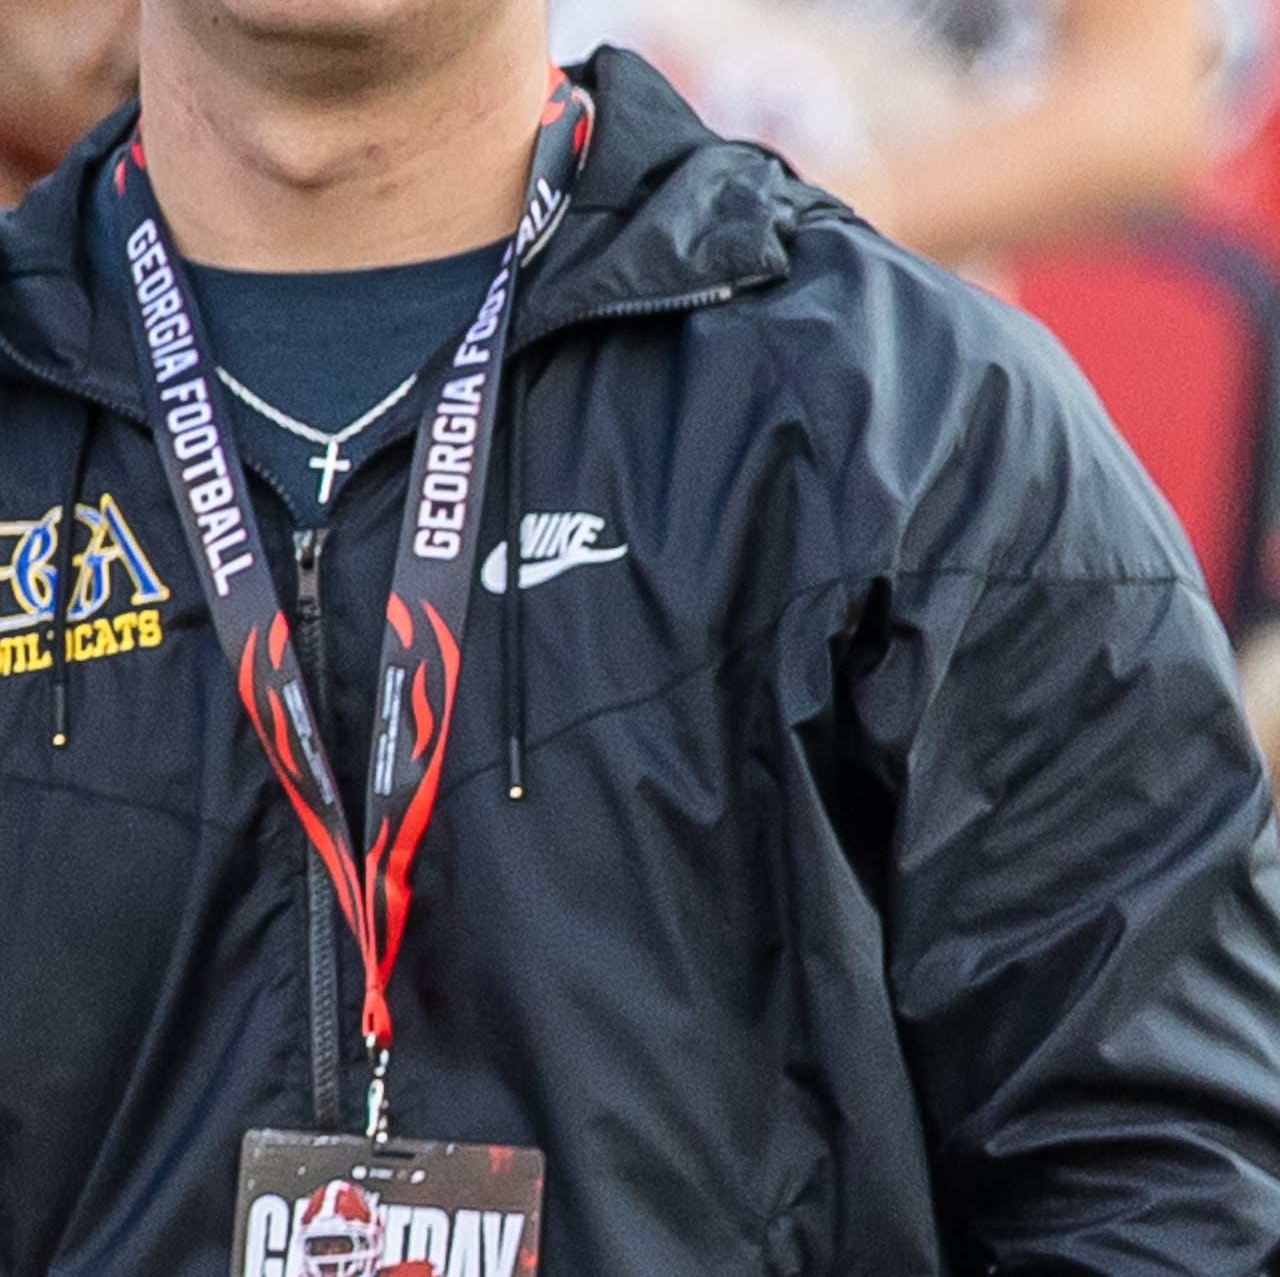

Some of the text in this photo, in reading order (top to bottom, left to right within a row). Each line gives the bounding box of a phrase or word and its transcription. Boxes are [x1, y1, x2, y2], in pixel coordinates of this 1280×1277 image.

[126, 219, 255, 597] GEORGIA FOOTBALL
[413, 372, 486, 560] GEORGIA
[519, 511, 605, 559] NIKE
